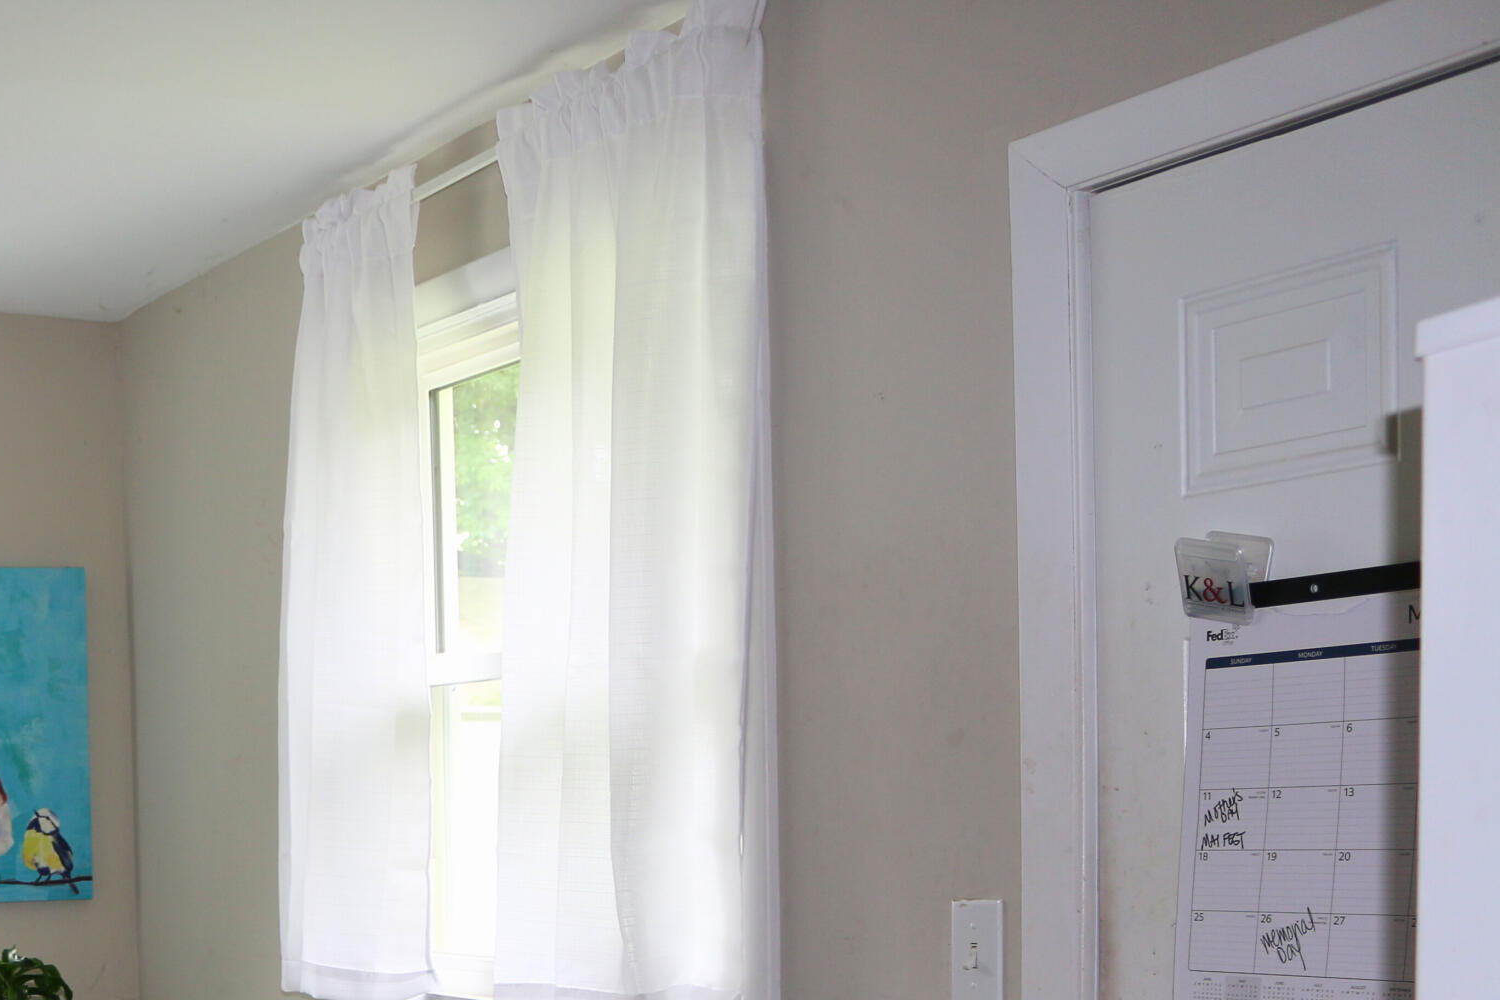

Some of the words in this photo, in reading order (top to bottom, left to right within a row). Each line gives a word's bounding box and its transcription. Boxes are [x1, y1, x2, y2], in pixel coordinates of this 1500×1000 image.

[1183, 574, 1245, 608] K&L
[1230, 657, 1252, 666] SUNDAY
[1297, 650, 1323, 659] MONDAY
[1371, 643, 1397, 652] TUESDAY
[1274, 727, 1280, 736] 5
[1346, 723, 1352, 732] 6
[1205, 731, 1211, 740] 4
[1203, 792, 1211, 801] 11
[1272, 789, 1281, 799] 12
[1345, 787, 1354, 797] 13
[1199, 851, 1208, 861] 18
[1267, 851, 1277, 861] 19
[1338, 851, 1351, 861] 20
[1194, 912, 1204, 922] 25
[1261, 914, 1272, 923] 26
[1333, 916, 1345, 925] 27
